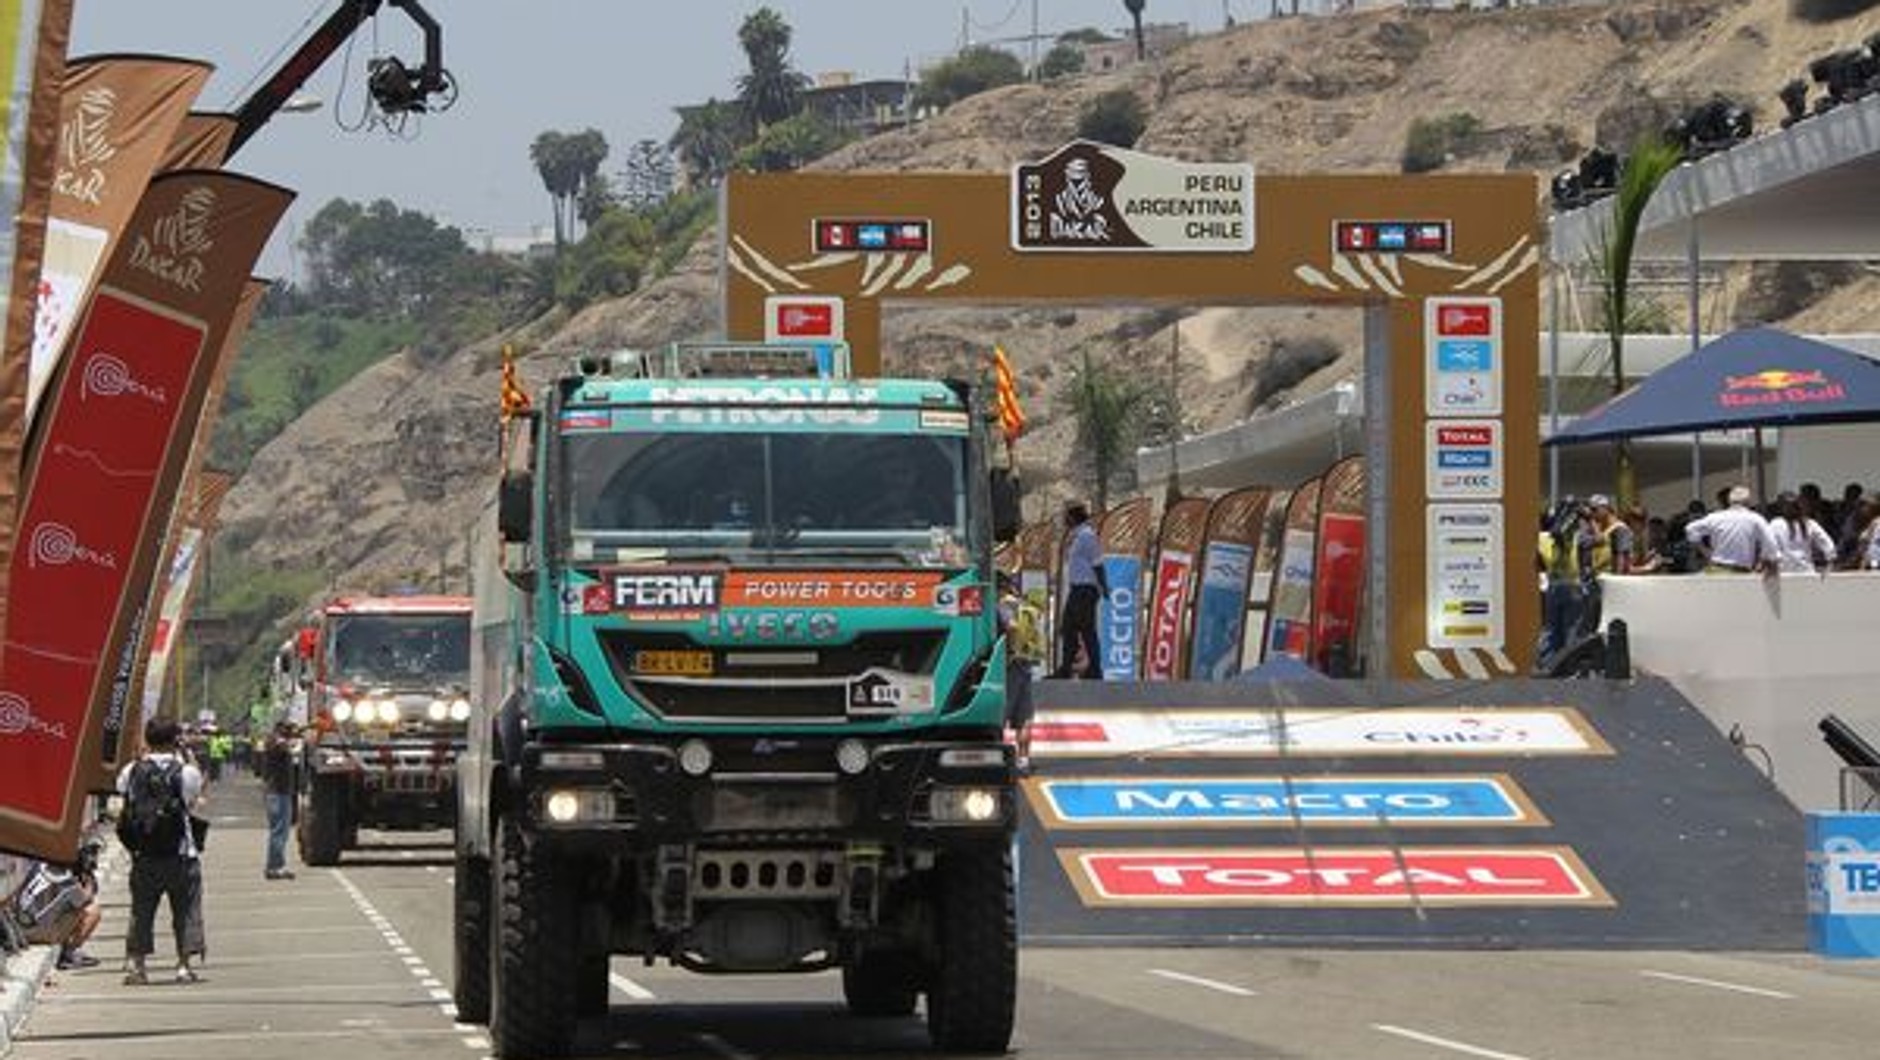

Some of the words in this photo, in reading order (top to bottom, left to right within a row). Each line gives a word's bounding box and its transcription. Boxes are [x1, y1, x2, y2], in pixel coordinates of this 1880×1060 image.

[53, 169, 105, 205] KAR
[1185, 175, 1242, 192] PERU
[1125, 198, 1242, 216] ARGENTINA
[1050, 212, 1112, 240] DAKAR
[1185, 222, 1242, 239] CHILE
[651, 386, 878, 425] PETRONAS
[1721, 389, 1779, 407] Red
[1784, 382, 1847, 402] Bull
[1442, 430, 1489, 443] TOTAL
[615, 575, 717, 605] FERM
[745, 581, 830, 599] POWER
[840, 581, 917, 599] TOOLS
[707, 611, 839, 638] IVECO
[1363, 729, 1500, 743] Chile
[1113, 789, 1453, 810] Macro
[1118, 864, 1546, 887] TOTAL
[1840, 863, 1880, 892] TE
